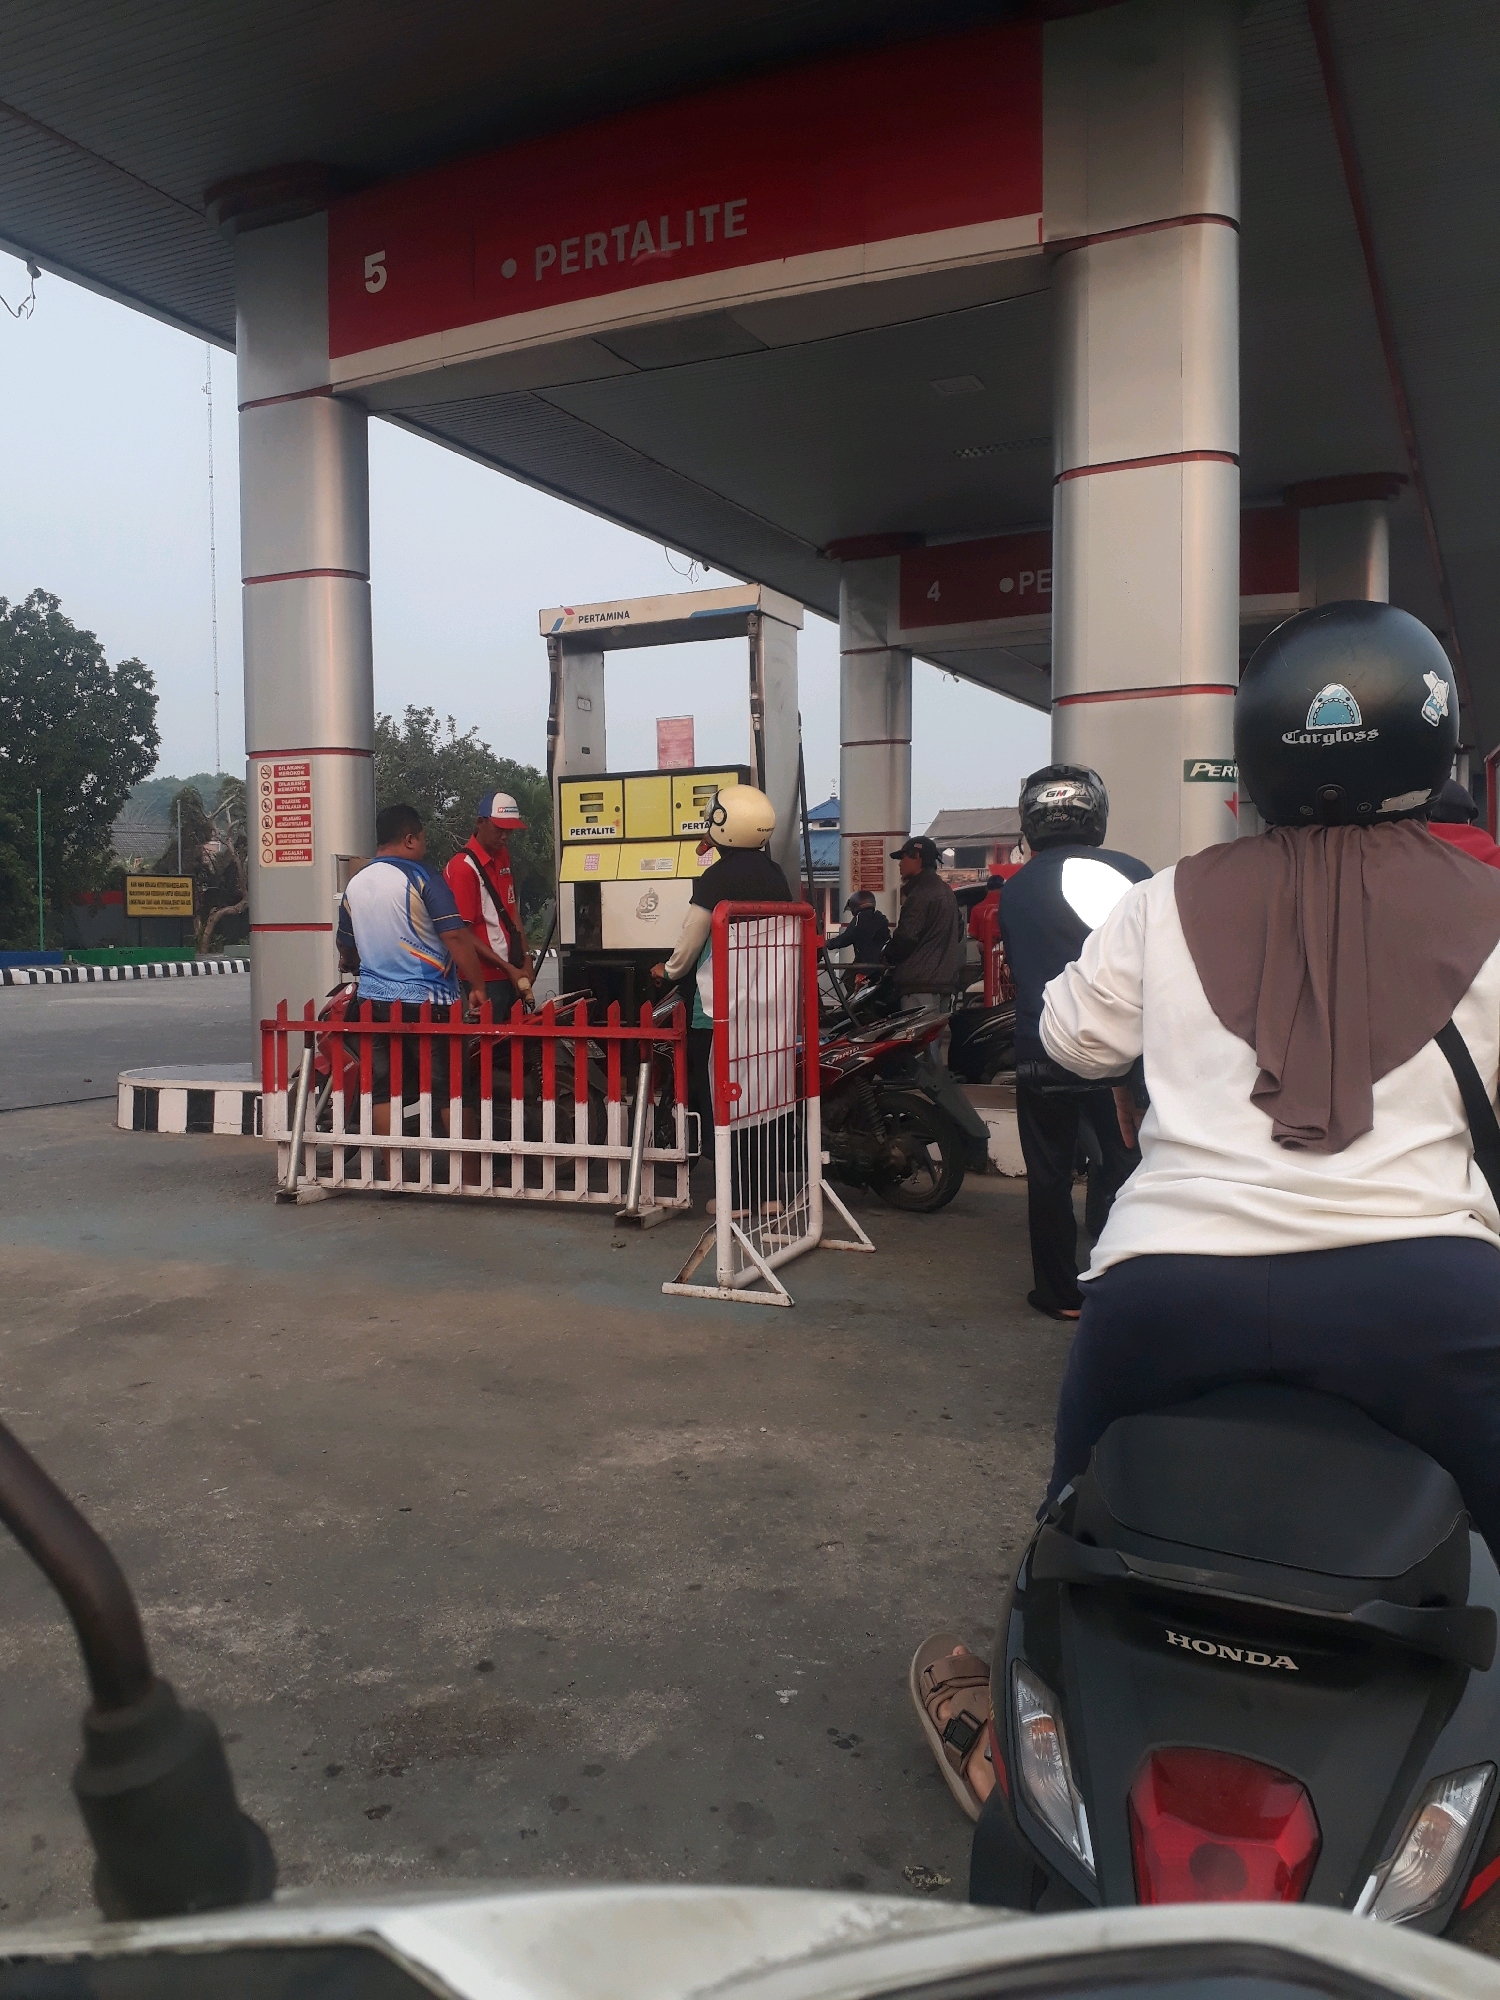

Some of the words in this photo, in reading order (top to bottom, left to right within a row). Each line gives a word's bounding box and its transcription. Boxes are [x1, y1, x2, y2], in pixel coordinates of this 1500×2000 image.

[534, 198, 748, 282] PERTALITE
[364, 250, 388, 294] 5
[926, 580, 942, 602] 4
[578, 610, 631, 624] PERTAMINA
[1281, 728, 1380, 748] Cargloss
[1045, 789, 1069, 798] GM
[570, 826, 616, 836] PERTALITE
[1165, 1629, 1300, 1671] HONDA
